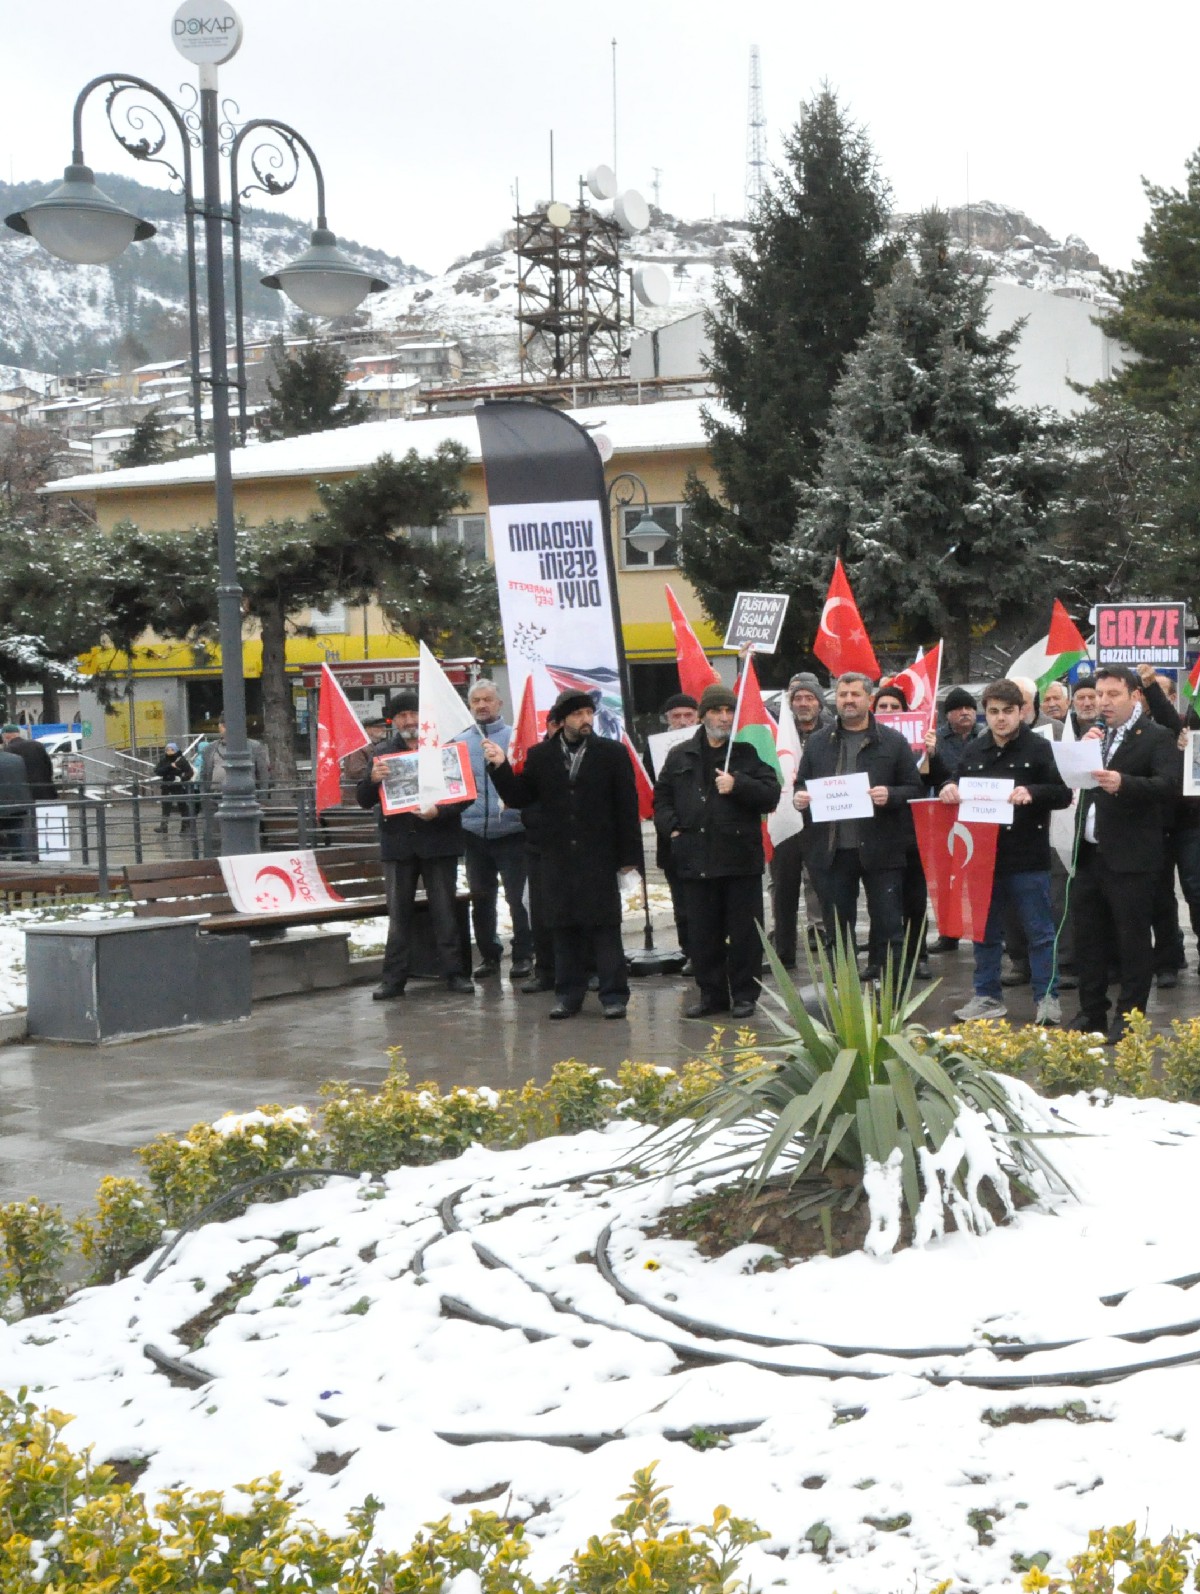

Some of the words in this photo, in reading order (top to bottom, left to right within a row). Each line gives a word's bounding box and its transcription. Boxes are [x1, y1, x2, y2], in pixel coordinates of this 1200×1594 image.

[174, 16, 236, 36] DOKAP
[736, 625, 771, 640] DURDUR
[1099, 608, 1179, 647] GAZZE
